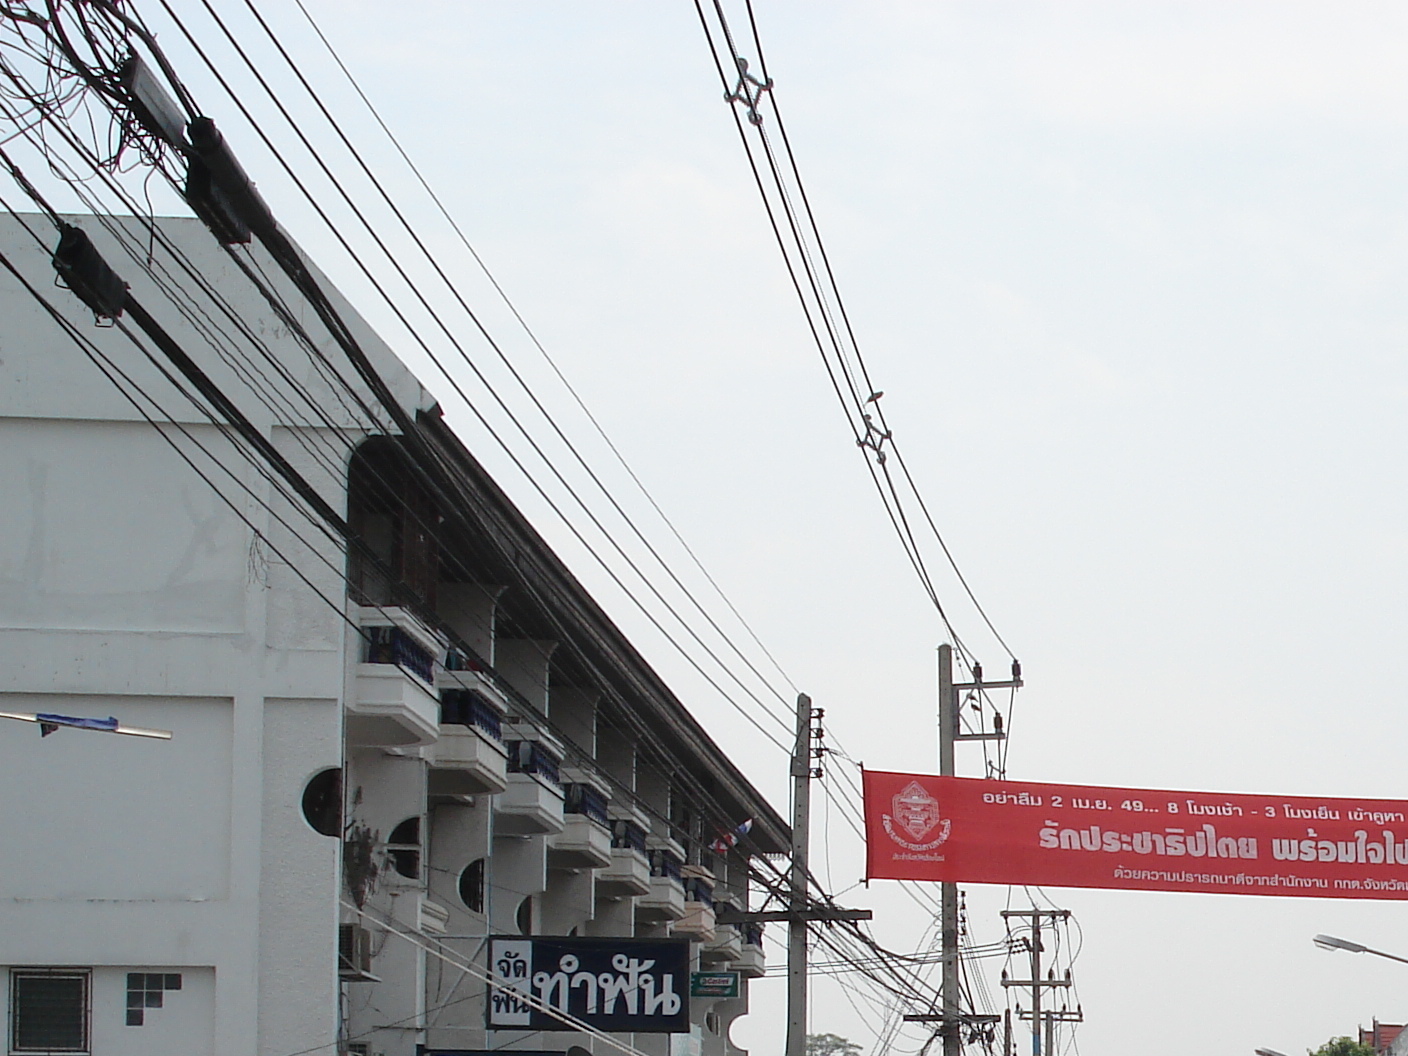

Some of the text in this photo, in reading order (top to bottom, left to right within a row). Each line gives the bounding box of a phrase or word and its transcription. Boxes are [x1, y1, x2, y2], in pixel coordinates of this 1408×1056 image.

[983, 791, 1042, 806] อย่าลืม
[1051, 796, 1063, 807] 2
[1072, 798, 1112, 810] เม.ย.
[1167, 802, 1179, 814] 8
[1186, 800, 1243, 817] โมงเช้า
[1265, 806, 1276, 818] 3
[1283, 803, 1340, 820] โมงเย็น
[1348, 808, 1405, 826] เข้าคูหา
[1039, 820, 1258, 859] รักประชาธิปไตย
[1113, 865, 1328, 889] ด้วยความปรารถนาดีจากสำนักงาน
[497, 951, 527, 978] จัด
[533, 953, 682, 1016] ทำฟัน
